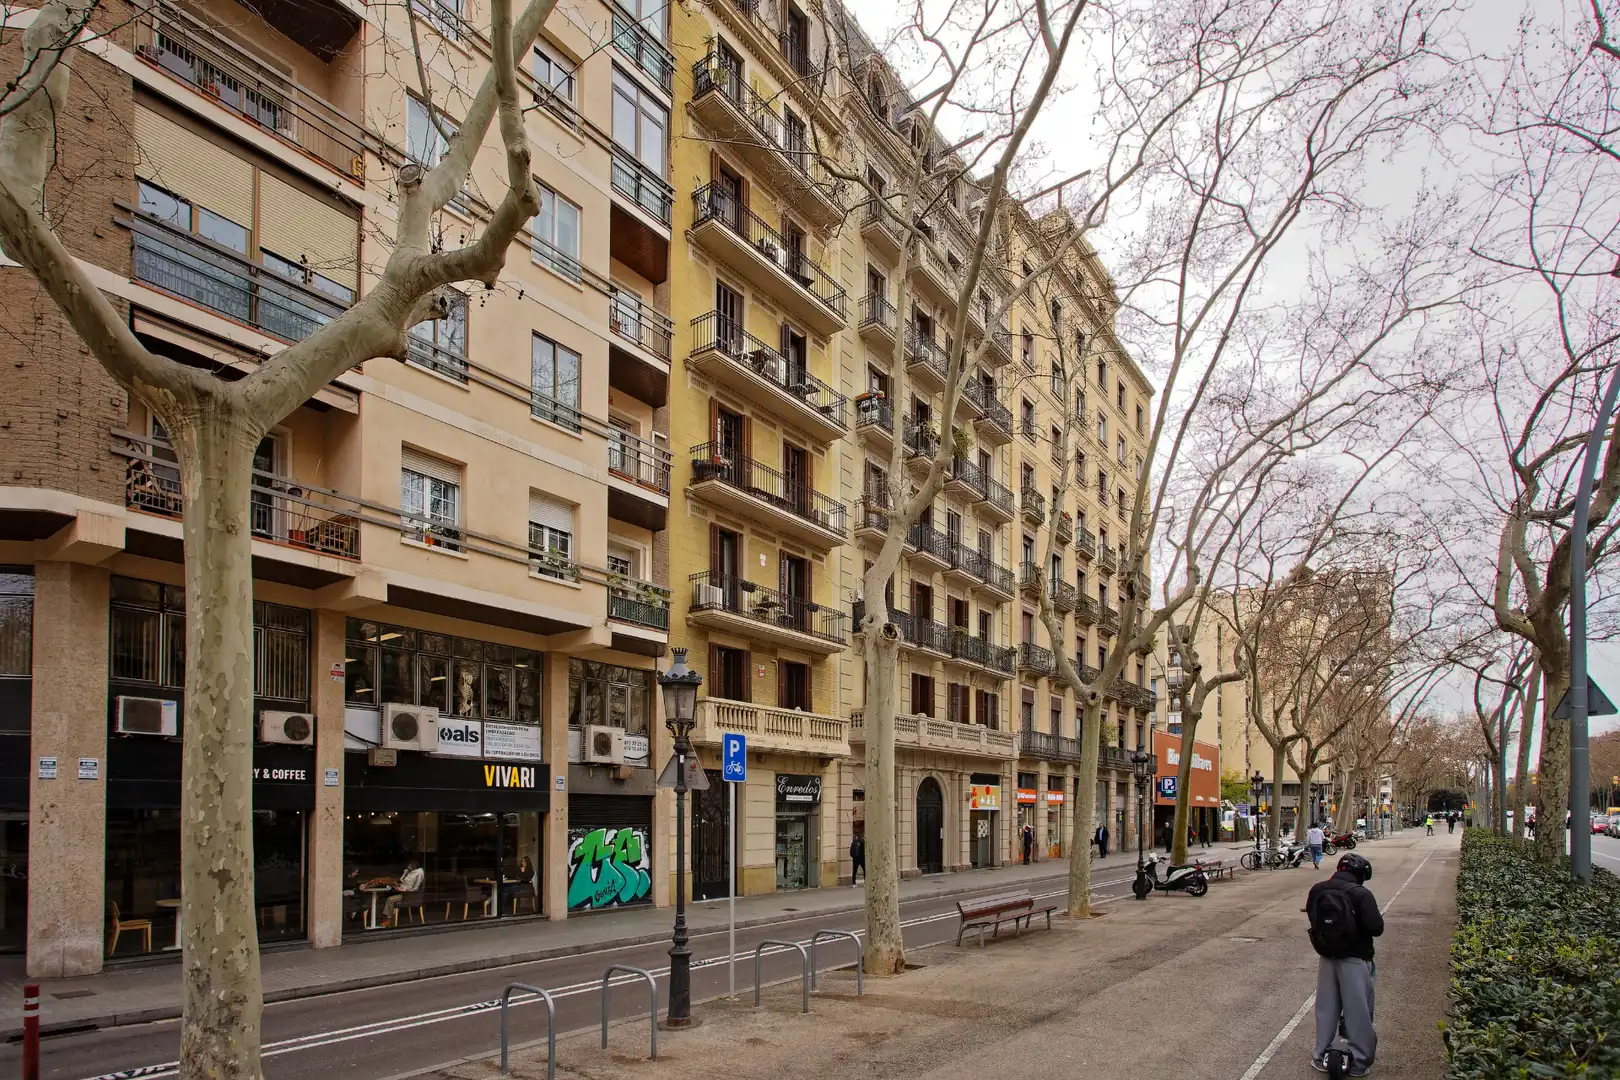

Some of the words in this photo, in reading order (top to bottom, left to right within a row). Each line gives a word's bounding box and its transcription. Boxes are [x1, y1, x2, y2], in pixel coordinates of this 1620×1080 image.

[437, 725, 480, 743] oals
[729, 739, 740, 758] P
[262, 768, 270, 779] &
[271, 769, 306, 780] COFFEE
[484, 765, 535, 788] VIVARI
[777, 775, 818, 795] Enredos
[1164, 778, 1174, 790] P
